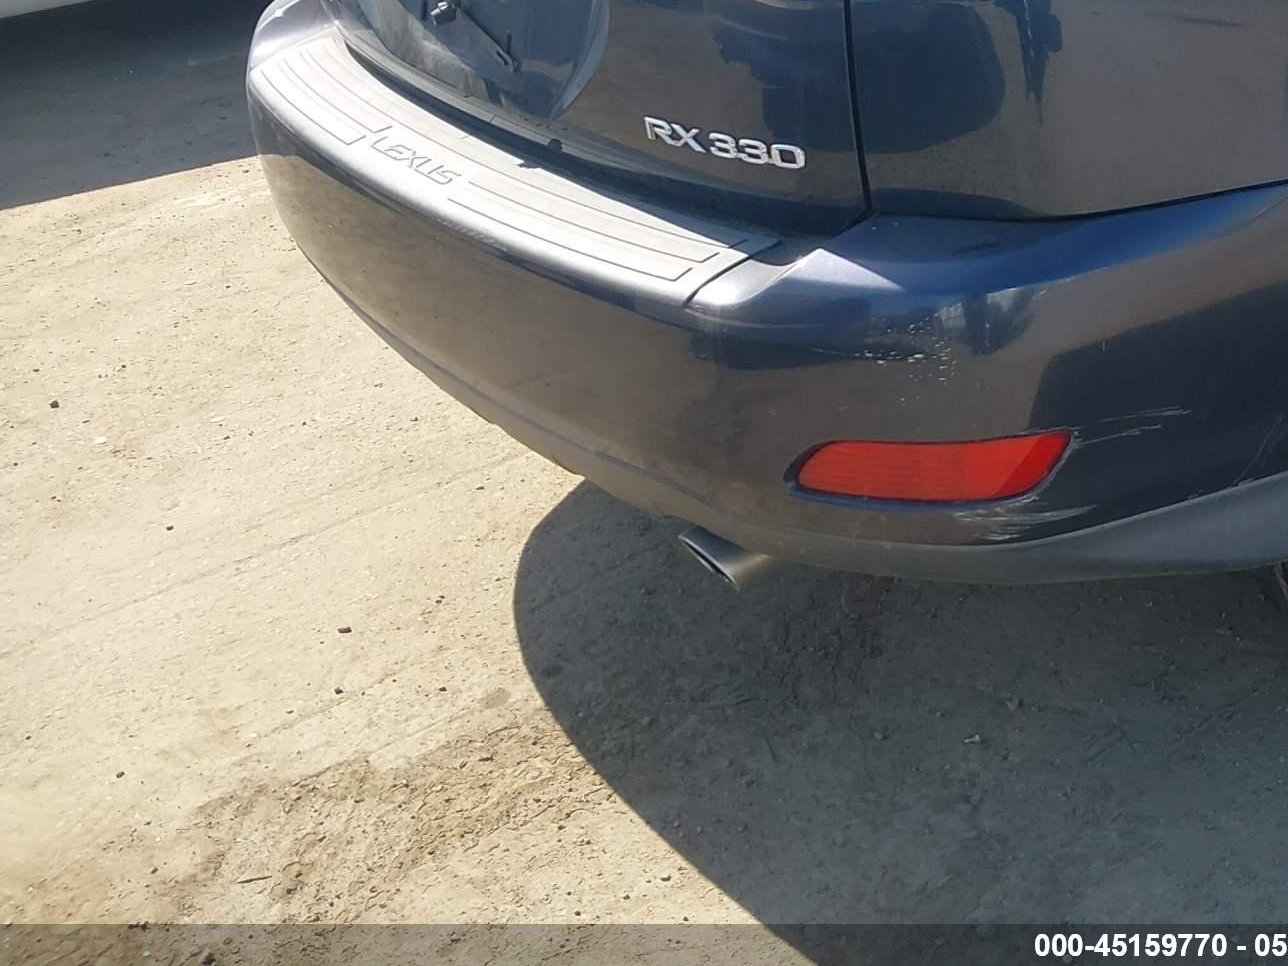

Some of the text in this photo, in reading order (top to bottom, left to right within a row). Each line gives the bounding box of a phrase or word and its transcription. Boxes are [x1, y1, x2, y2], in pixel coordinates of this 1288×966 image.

[370, 136, 462, 185] LEXUS
[644, 116, 806, 169] RX 330
